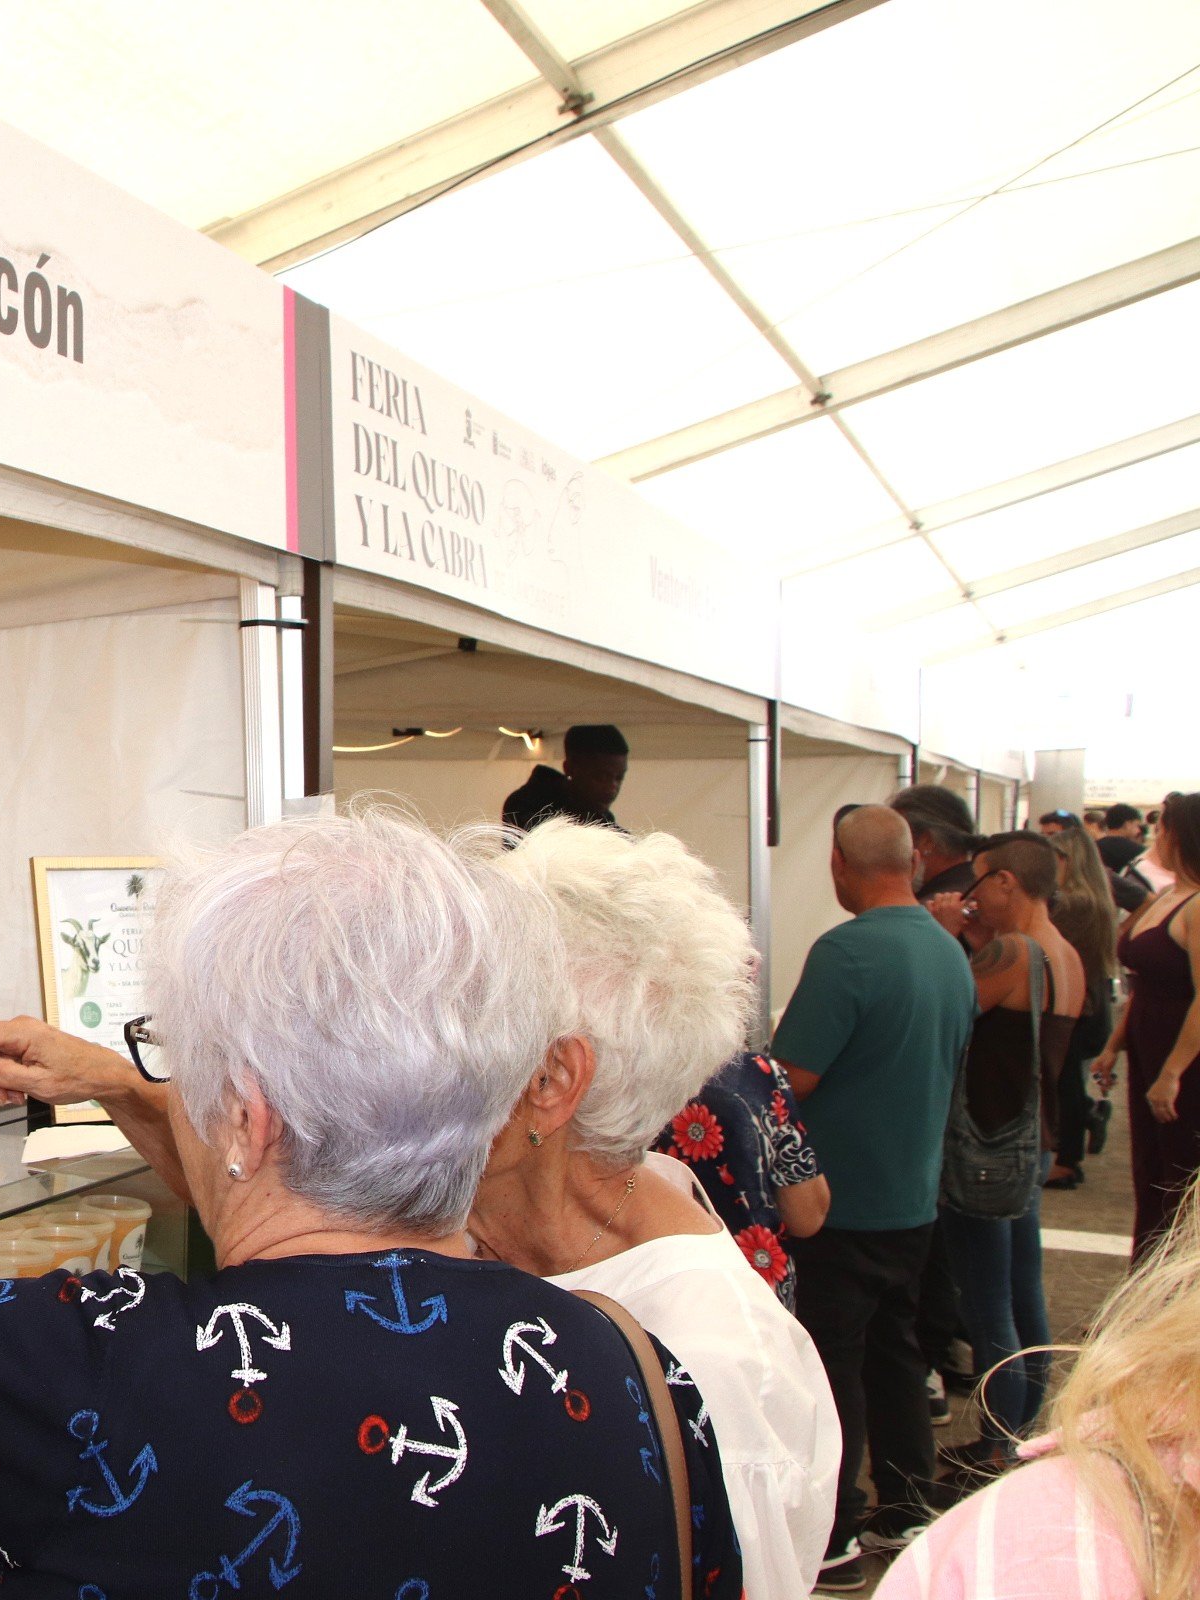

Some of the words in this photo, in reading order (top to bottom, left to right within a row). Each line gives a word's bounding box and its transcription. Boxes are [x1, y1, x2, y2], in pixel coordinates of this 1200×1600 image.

[350, 350, 428, 436] FERIA
[352, 421, 407, 492] DEL
[411, 450, 486, 526] QUESO
[354, 494, 373, 548] Y
[381, 502, 416, 562] LA
[420, 519, 488, 589] CABRA
